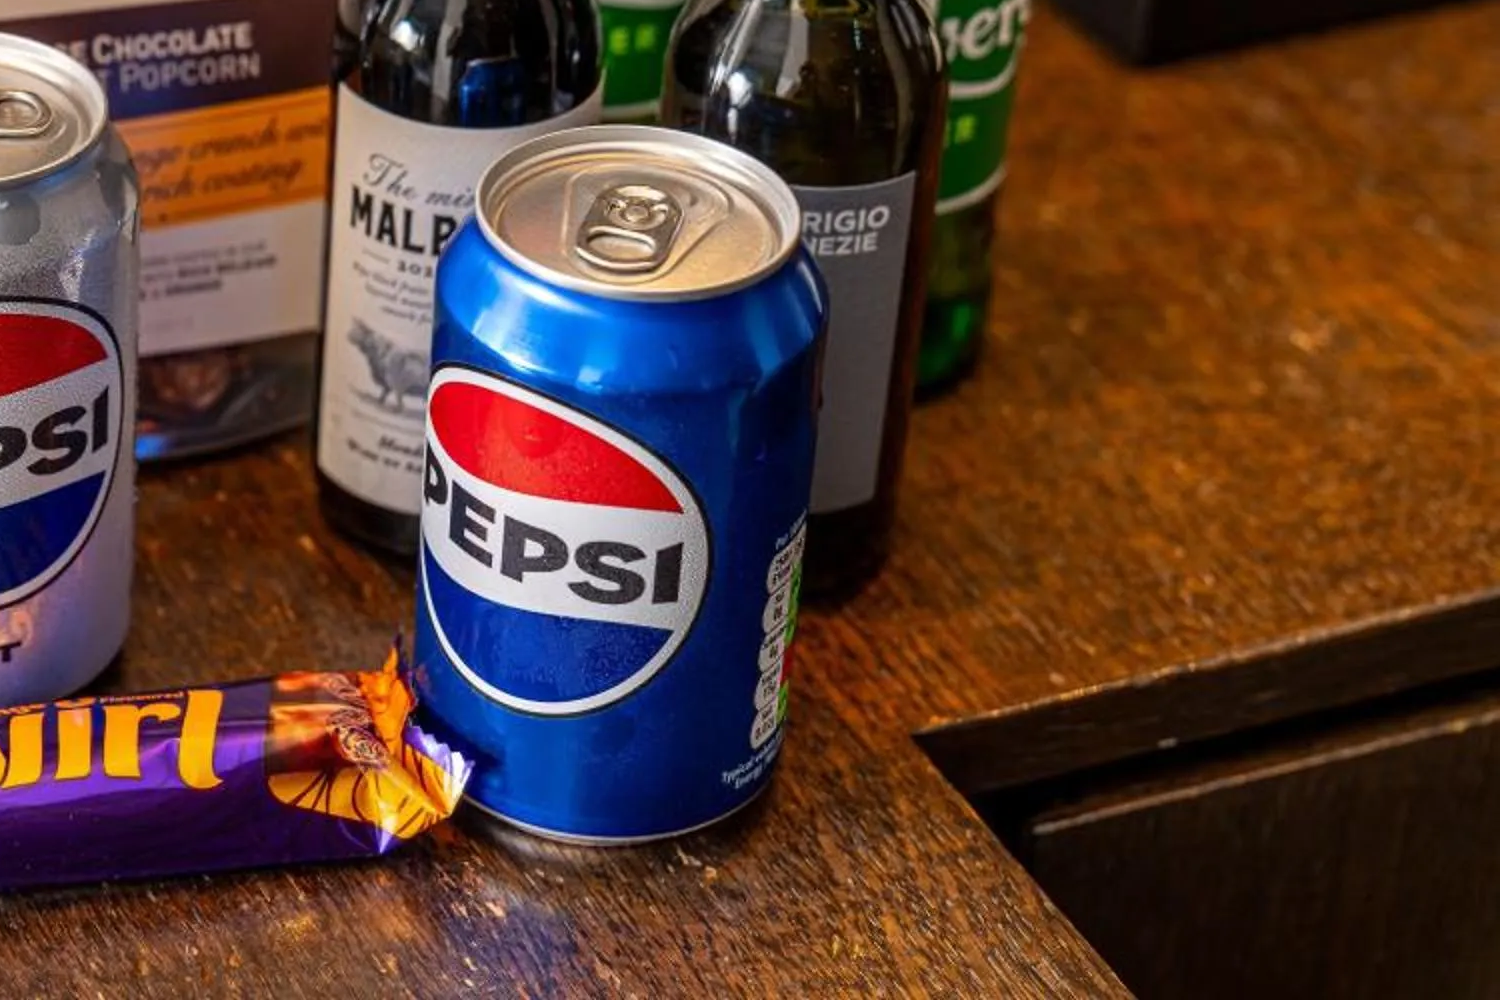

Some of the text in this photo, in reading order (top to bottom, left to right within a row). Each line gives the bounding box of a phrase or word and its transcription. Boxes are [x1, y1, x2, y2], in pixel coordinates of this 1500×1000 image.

[92, 22, 254, 64] CHOCOLATE
[119, 53, 261, 92] POPCORN
[362, 153, 419, 199] The
[424, 442, 686, 605] PEPSI
